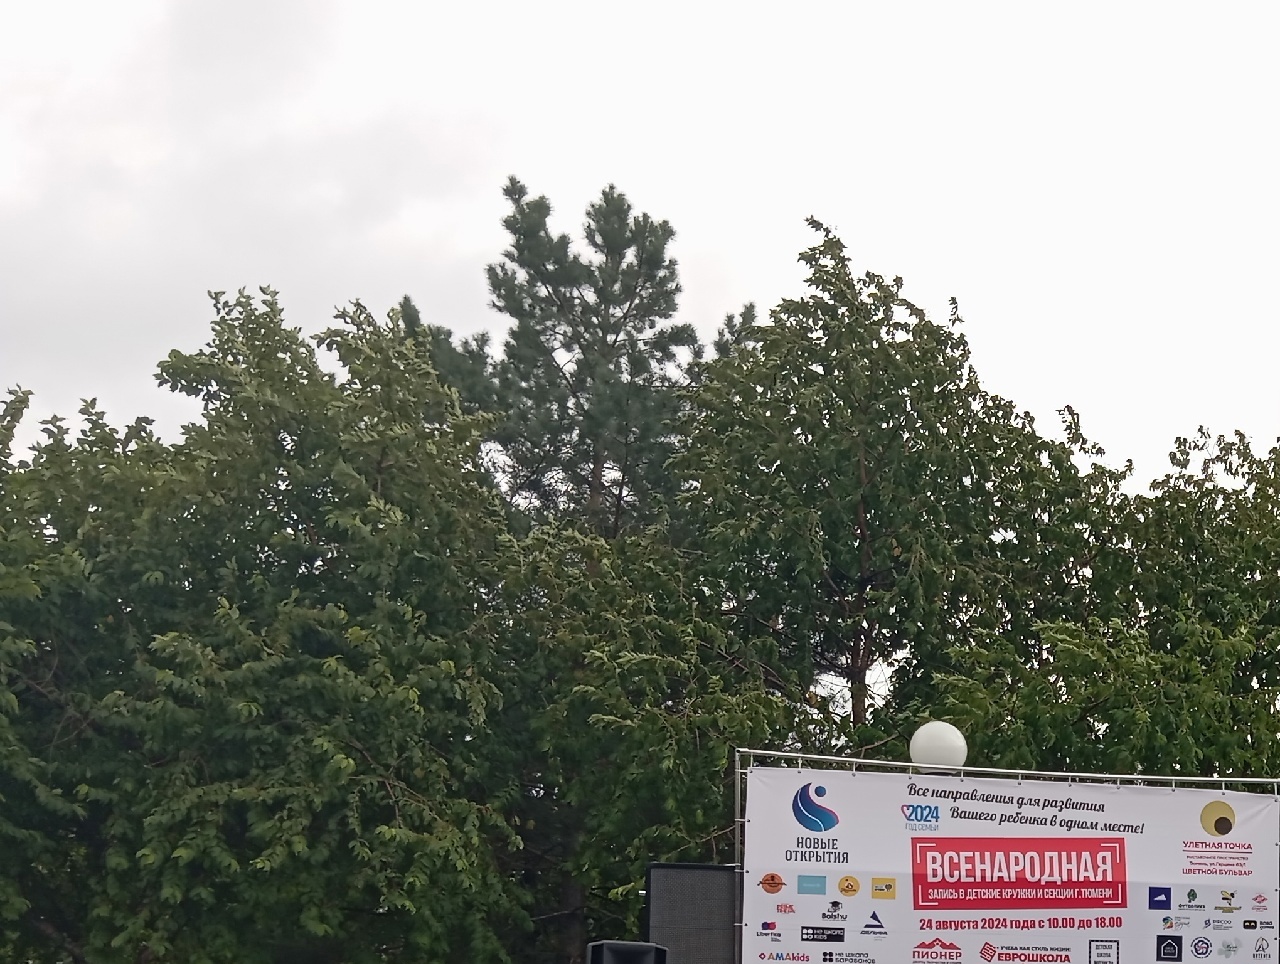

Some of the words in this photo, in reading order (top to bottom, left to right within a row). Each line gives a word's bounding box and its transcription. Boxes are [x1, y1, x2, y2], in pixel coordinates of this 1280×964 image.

[906, 783, 929, 797] Все
[930, 787, 1014, 806] направления
[1016, 795, 1040, 809] для
[1041, 797, 1105, 812] развития
[907, 804, 940, 823] 2024
[949, 806, 996, 822] Вашего
[998, 811, 1048, 827] ребенка
[1050, 812, 1058, 827] в
[1059, 819, 1098, 832] одном
[1100, 822, 1145, 835] месте!
[905, 823, 917, 831] ГОД
[918, 824, 939, 832] СЕМЬИ
[796, 837, 839, 850] НОВЫЕ
[1182, 841, 1223, 850] УЛЕТНАЯ
[1223, 842, 1253, 850] ТОЧКА
[785, 850, 849, 864] ОТКРЫТИЯ
[926, 851, 1112, 885] ВСЕНАРОДНАЯ
[1182, 867, 1217, 875] ЦВЕТНОЙ
[1219, 869, 1253, 877] БУЛЬВАР
[928, 888, 958, 900] ЗАПИСЬ
[959, 888, 965, 899] В
[966, 888, 1001, 900] ДЕТСКИЕ
[1002, 888, 1037, 899] КРУЖКИ
[1037, 888, 1043, 899] И
[1044, 888, 1074, 900] СЕКЦИИ
[919, 918, 933, 930] 24
[935, 918, 979, 931] августа
[980, 917, 1008, 929] 2024
[1009, 918, 1036, 930] года
[1038, 918, 1045, 929] с
[1046, 917, 1075, 929] 10.00
[1077, 918, 1092, 930] до
[1094, 916, 1123, 928] 18.00
[768, 952, 810, 963] AMAkids
[912, 950, 962, 961] ПИОНЕР
[997, 953, 1071, 963] ЕВРОШКОЛА
